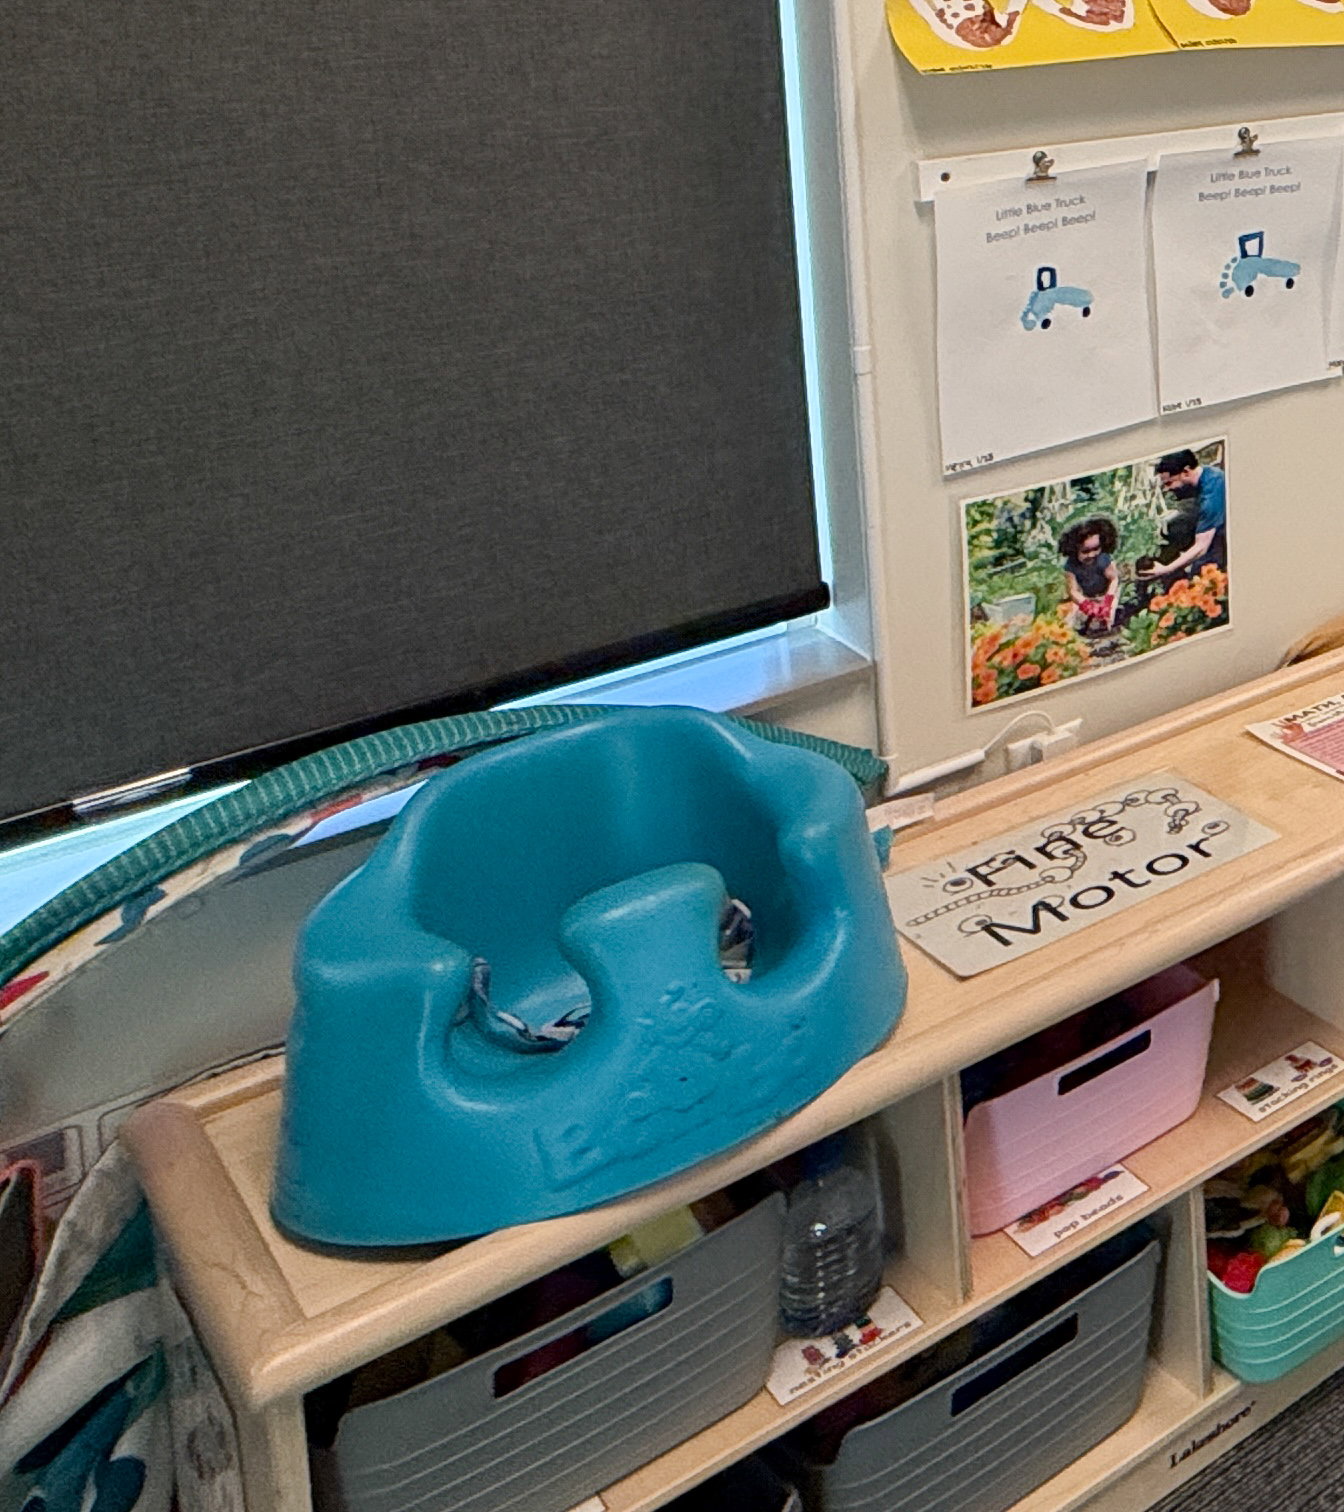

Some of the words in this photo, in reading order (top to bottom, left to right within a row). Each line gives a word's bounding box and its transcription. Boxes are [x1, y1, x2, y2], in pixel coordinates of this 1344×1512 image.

[1198, 188, 1233, 203] Beep!
[1234, 185, 1267, 199] Beep!
[1269, 181, 1301, 196] Beep!
[1210, 171, 1236, 184] Little
[1238, 169, 1261, 181] Blue
[1264, 165, 1293, 178] Truck
[986, 226, 1021, 244] Beep!
[1024, 218, 1058, 235] Beep!
[1061, 210, 1096, 228] Beep!
[996, 206, 1023, 222] Little
[1026, 199, 1051, 215] Blue
[1055, 194, 1086, 209] Truck
[965, 819, 1118, 888] Fine
[981, 838, 1213, 947] Motor
[1257, 1082, 1309, 1115] stacking
[1309, 1063, 1338, 1084] rings
[1053, 1218, 1081, 1239] pop
[1080, 1193, 1125, 1226] beads
[789, 1359, 846, 1395] nesting
[848, 1321, 912, 1360] stackers
[1169, 1401, 1253, 1469] Lakeshore
